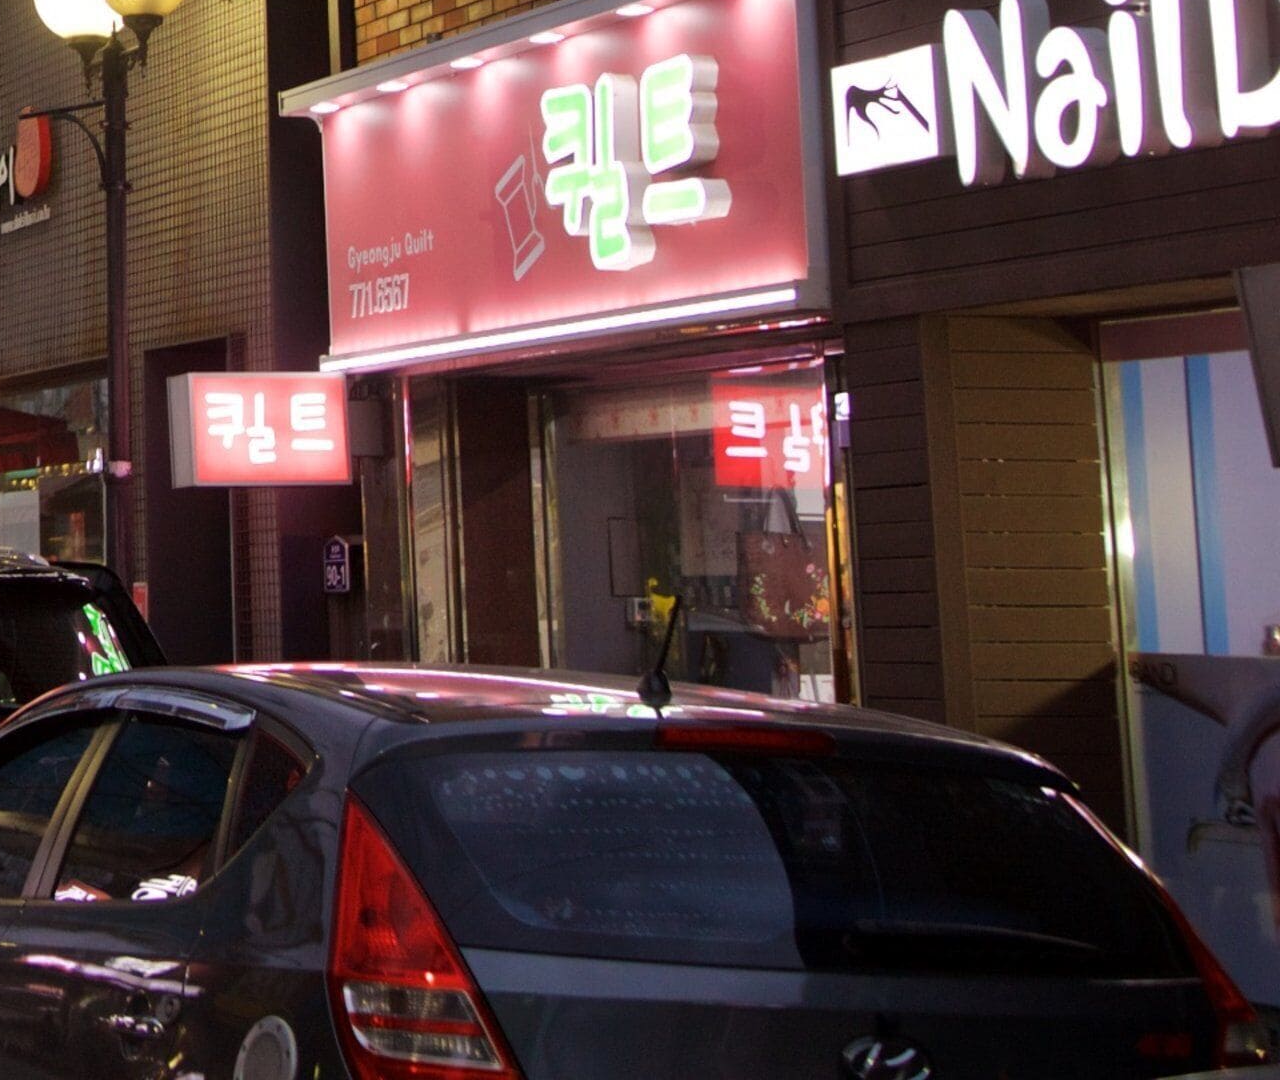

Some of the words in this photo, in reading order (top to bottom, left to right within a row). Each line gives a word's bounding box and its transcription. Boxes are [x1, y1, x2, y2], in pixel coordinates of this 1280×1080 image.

[347, 237, 401, 274] Gyeongju
[404, 228, 435, 257] Quilt
[203, 391, 335, 464] 퀼트
